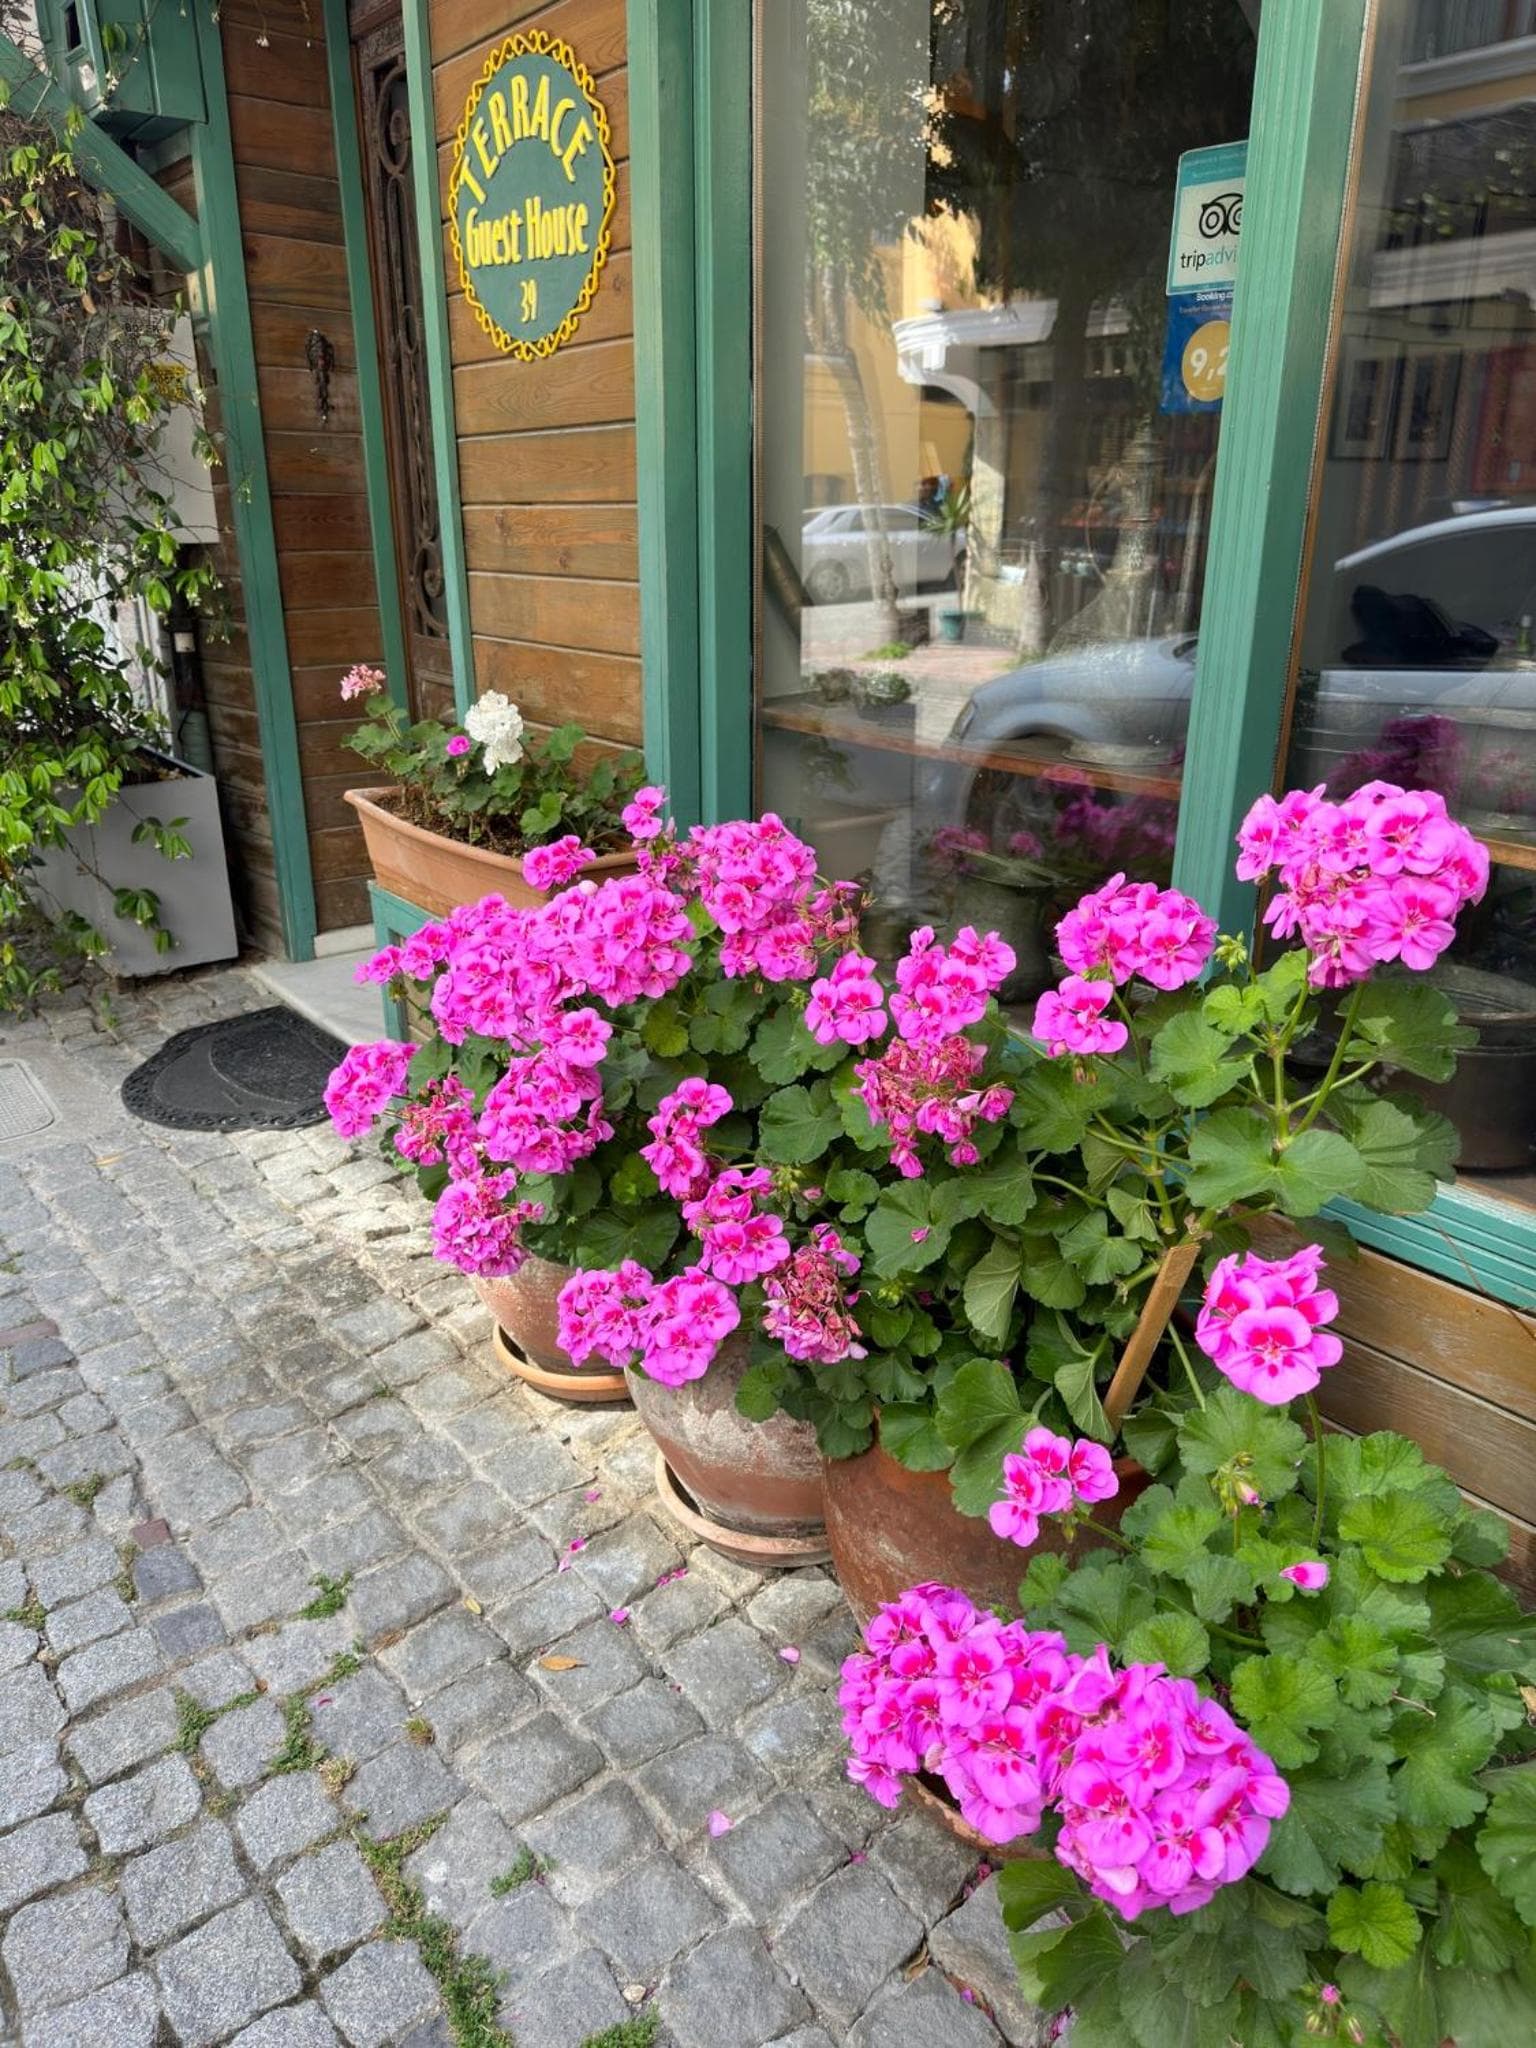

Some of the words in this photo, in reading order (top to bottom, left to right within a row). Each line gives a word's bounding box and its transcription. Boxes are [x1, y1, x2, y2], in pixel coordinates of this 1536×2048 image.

[458, 74, 593, 205] TERRACE
[465, 207, 523, 268] Guest
[525, 196, 589, 260] House
[520, 279, 537, 323] 39
